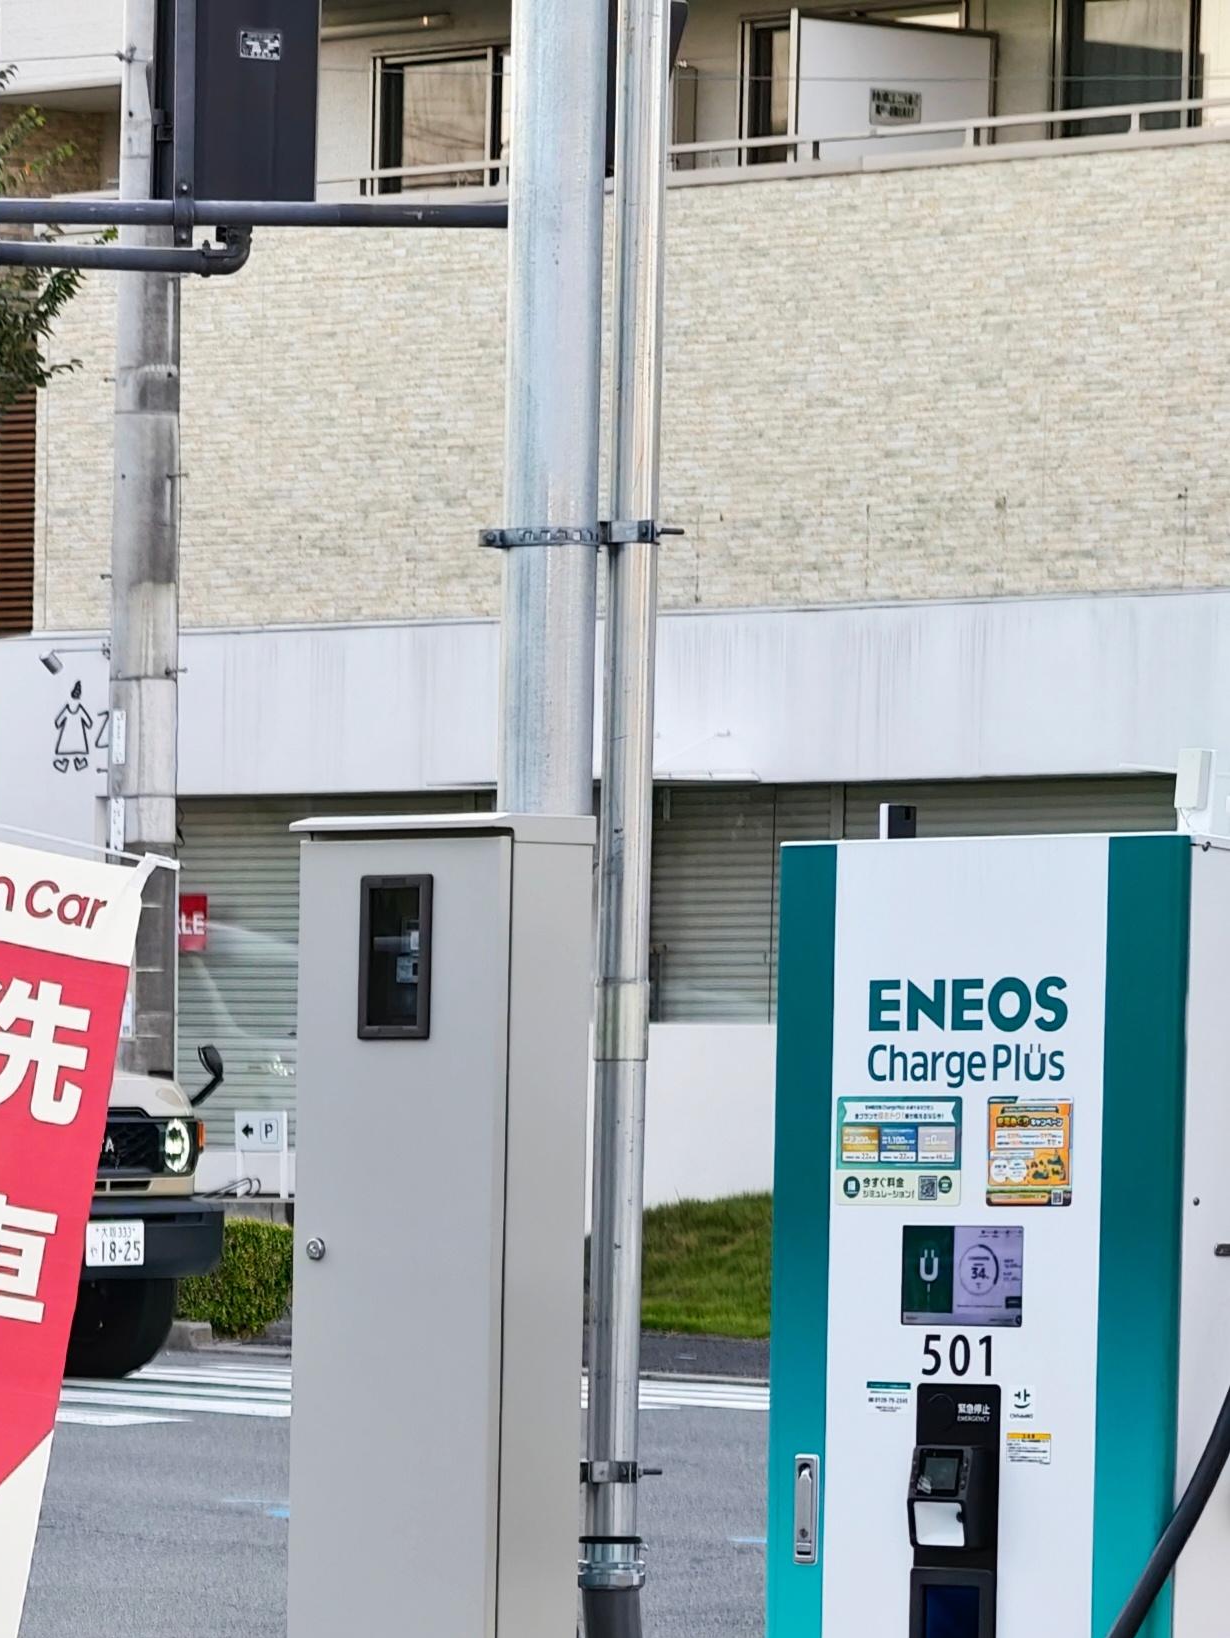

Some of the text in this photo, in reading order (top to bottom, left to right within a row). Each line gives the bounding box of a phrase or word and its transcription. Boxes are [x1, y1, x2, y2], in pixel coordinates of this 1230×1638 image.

[25, 880, 107, 929] Car
[178, 911, 205, 935] LE
[868, 976, 1069, 1032] ENEOS
[264, 1122, 273, 1139] P
[101, 1240, 141, 1263] 18-25
[921, 1334, 993, 1377] 501
[957, 1403, 991, 1415] 緊急停止
